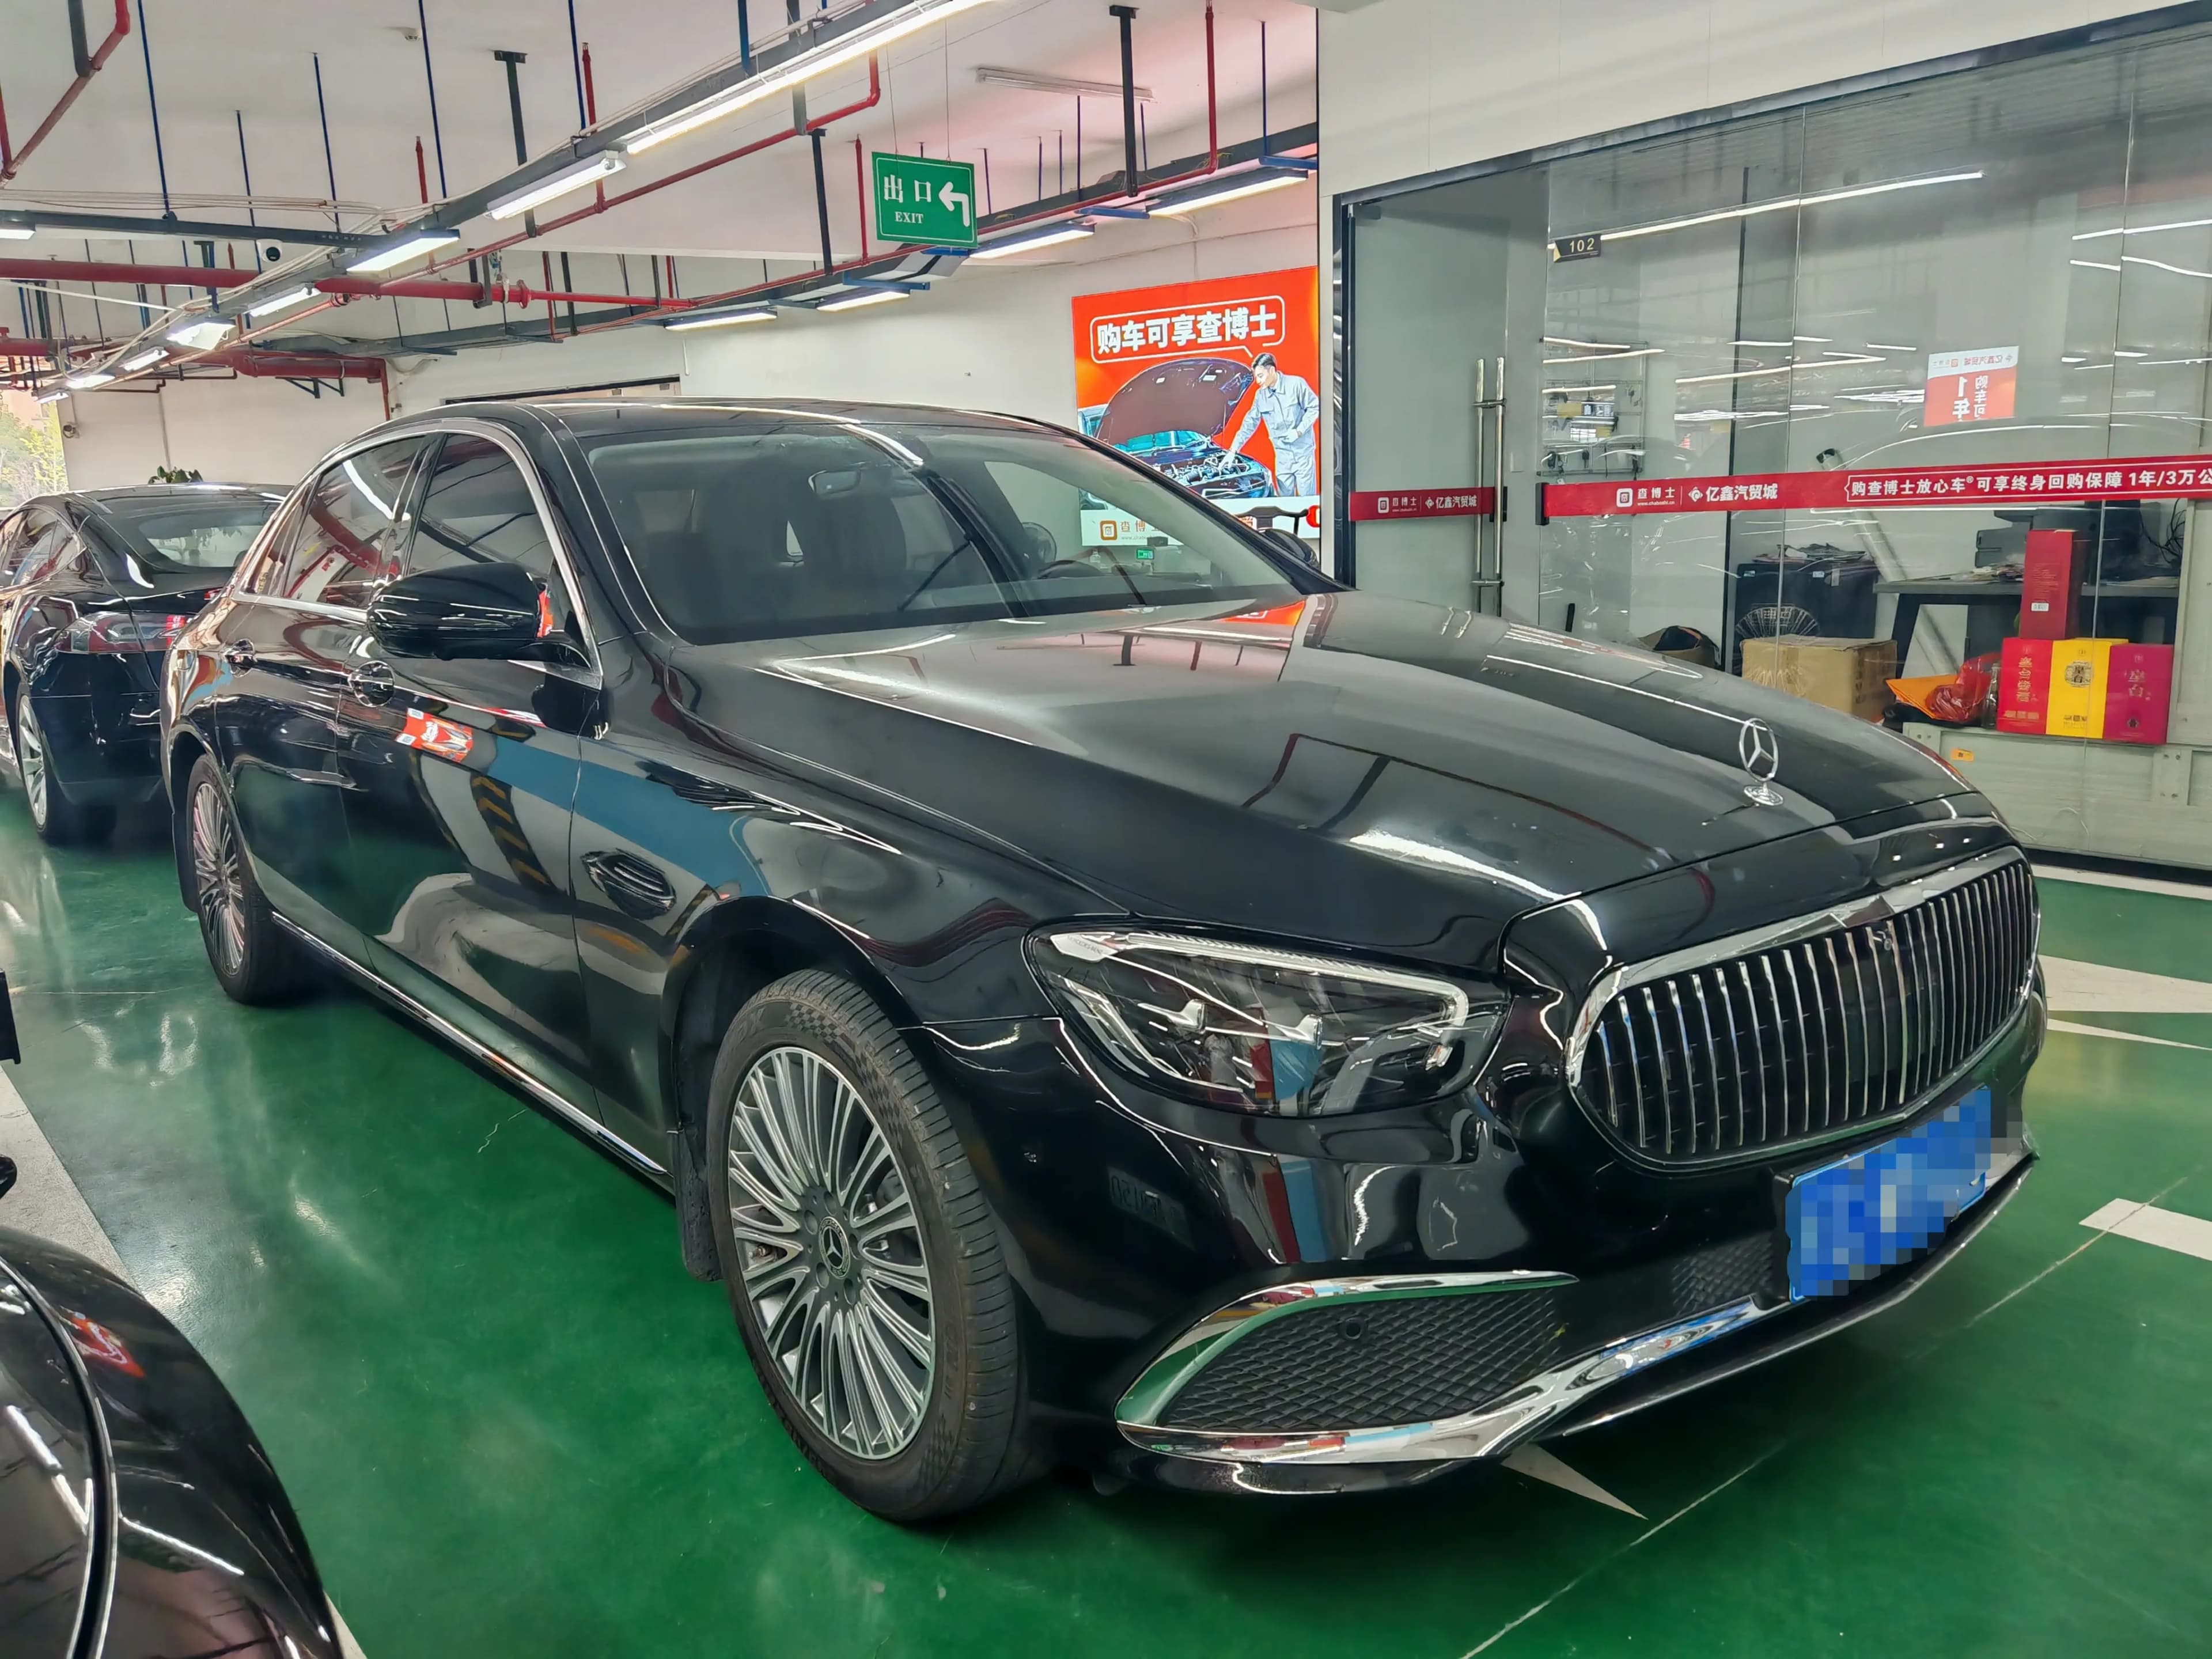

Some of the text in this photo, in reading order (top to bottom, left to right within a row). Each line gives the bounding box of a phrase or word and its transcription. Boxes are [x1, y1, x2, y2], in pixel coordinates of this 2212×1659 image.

[884, 175, 931, 203] 出口
[895, 211, 923, 224] EXIT
[1569, 237, 1594, 253] 102
[1096, 305, 1277, 355] 购车可享查博士
[1638, 483, 1778, 502] 查博士 亿鑫汽贸城
[1435, 495, 1477, 509] 亿鑫汽贸城
